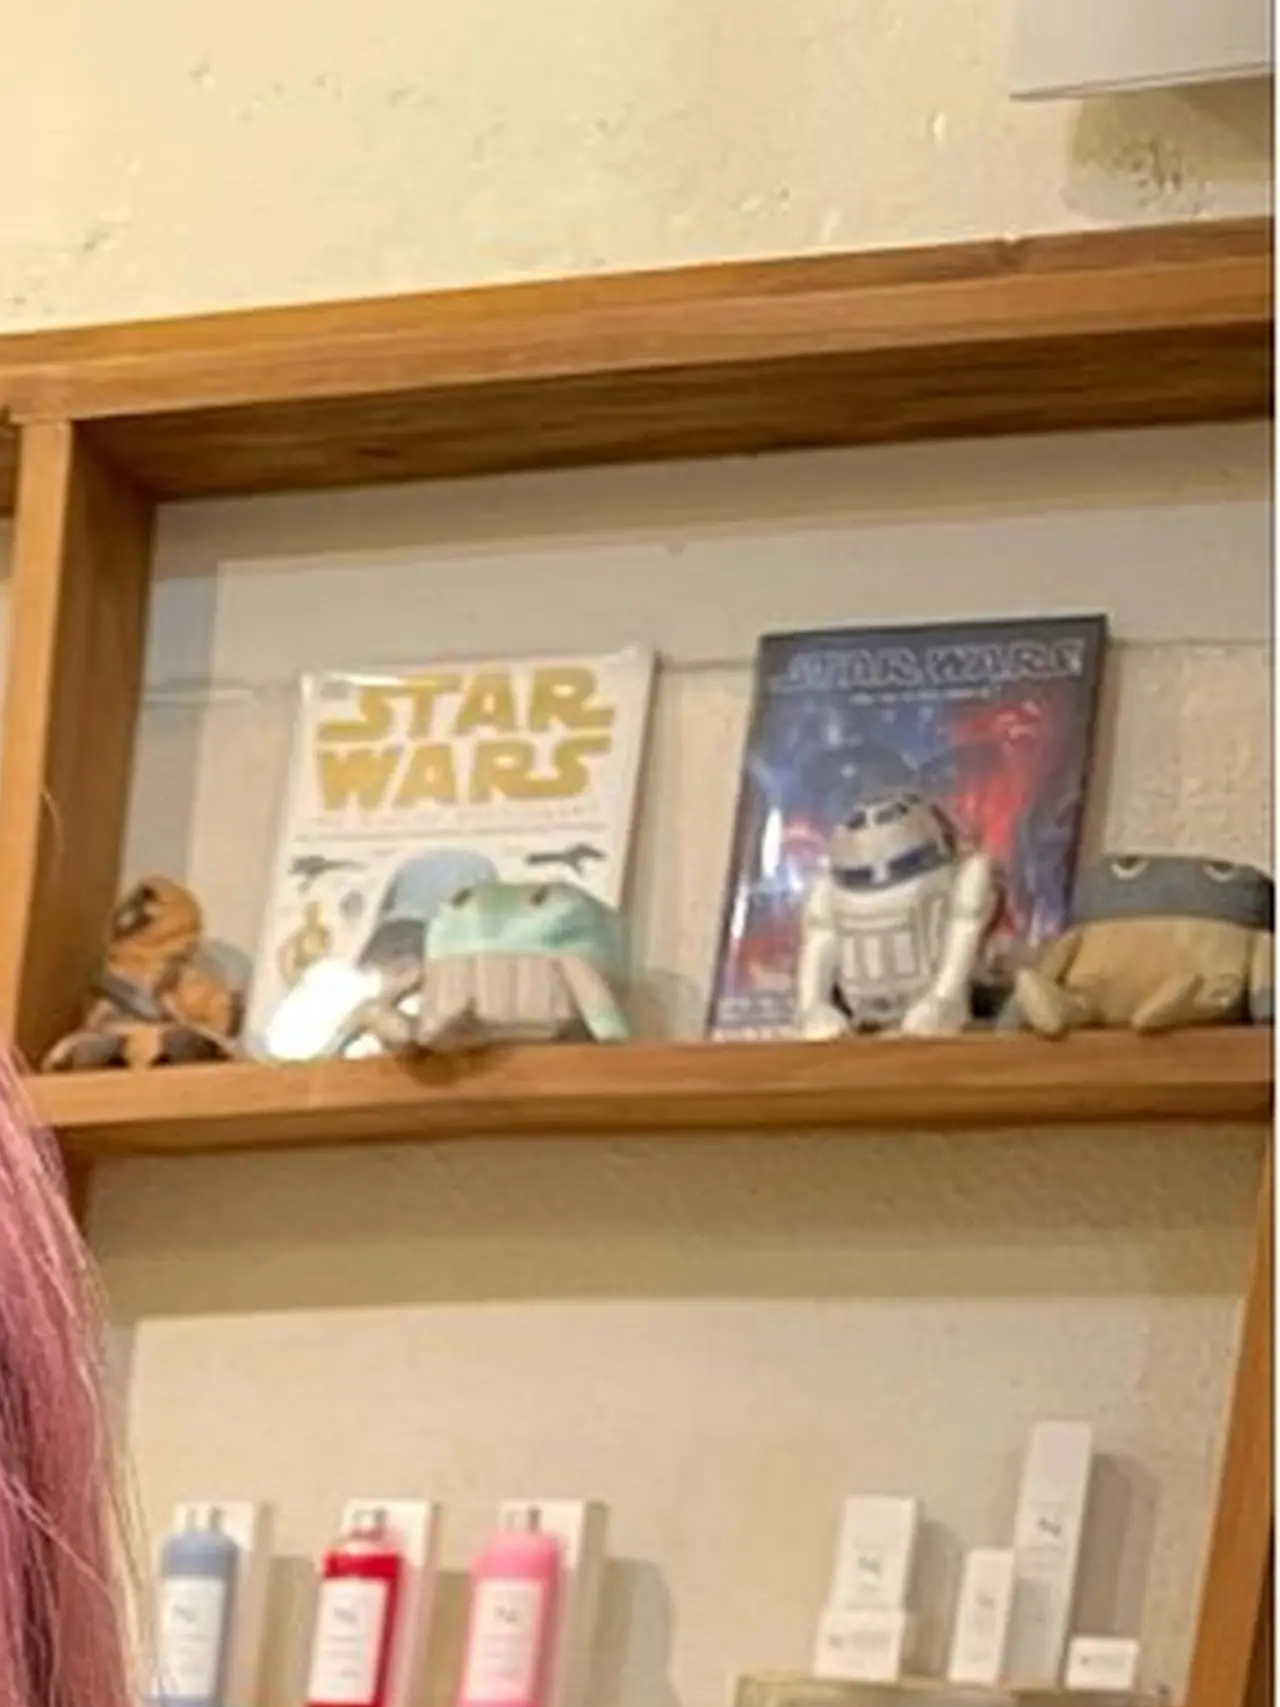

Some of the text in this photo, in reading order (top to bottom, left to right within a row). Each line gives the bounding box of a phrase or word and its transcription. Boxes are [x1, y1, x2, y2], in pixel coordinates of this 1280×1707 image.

[768, 637, 1086, 692] STAR WARS
[316, 666, 616, 743] STAR
[319, 733, 613, 812] WARS
